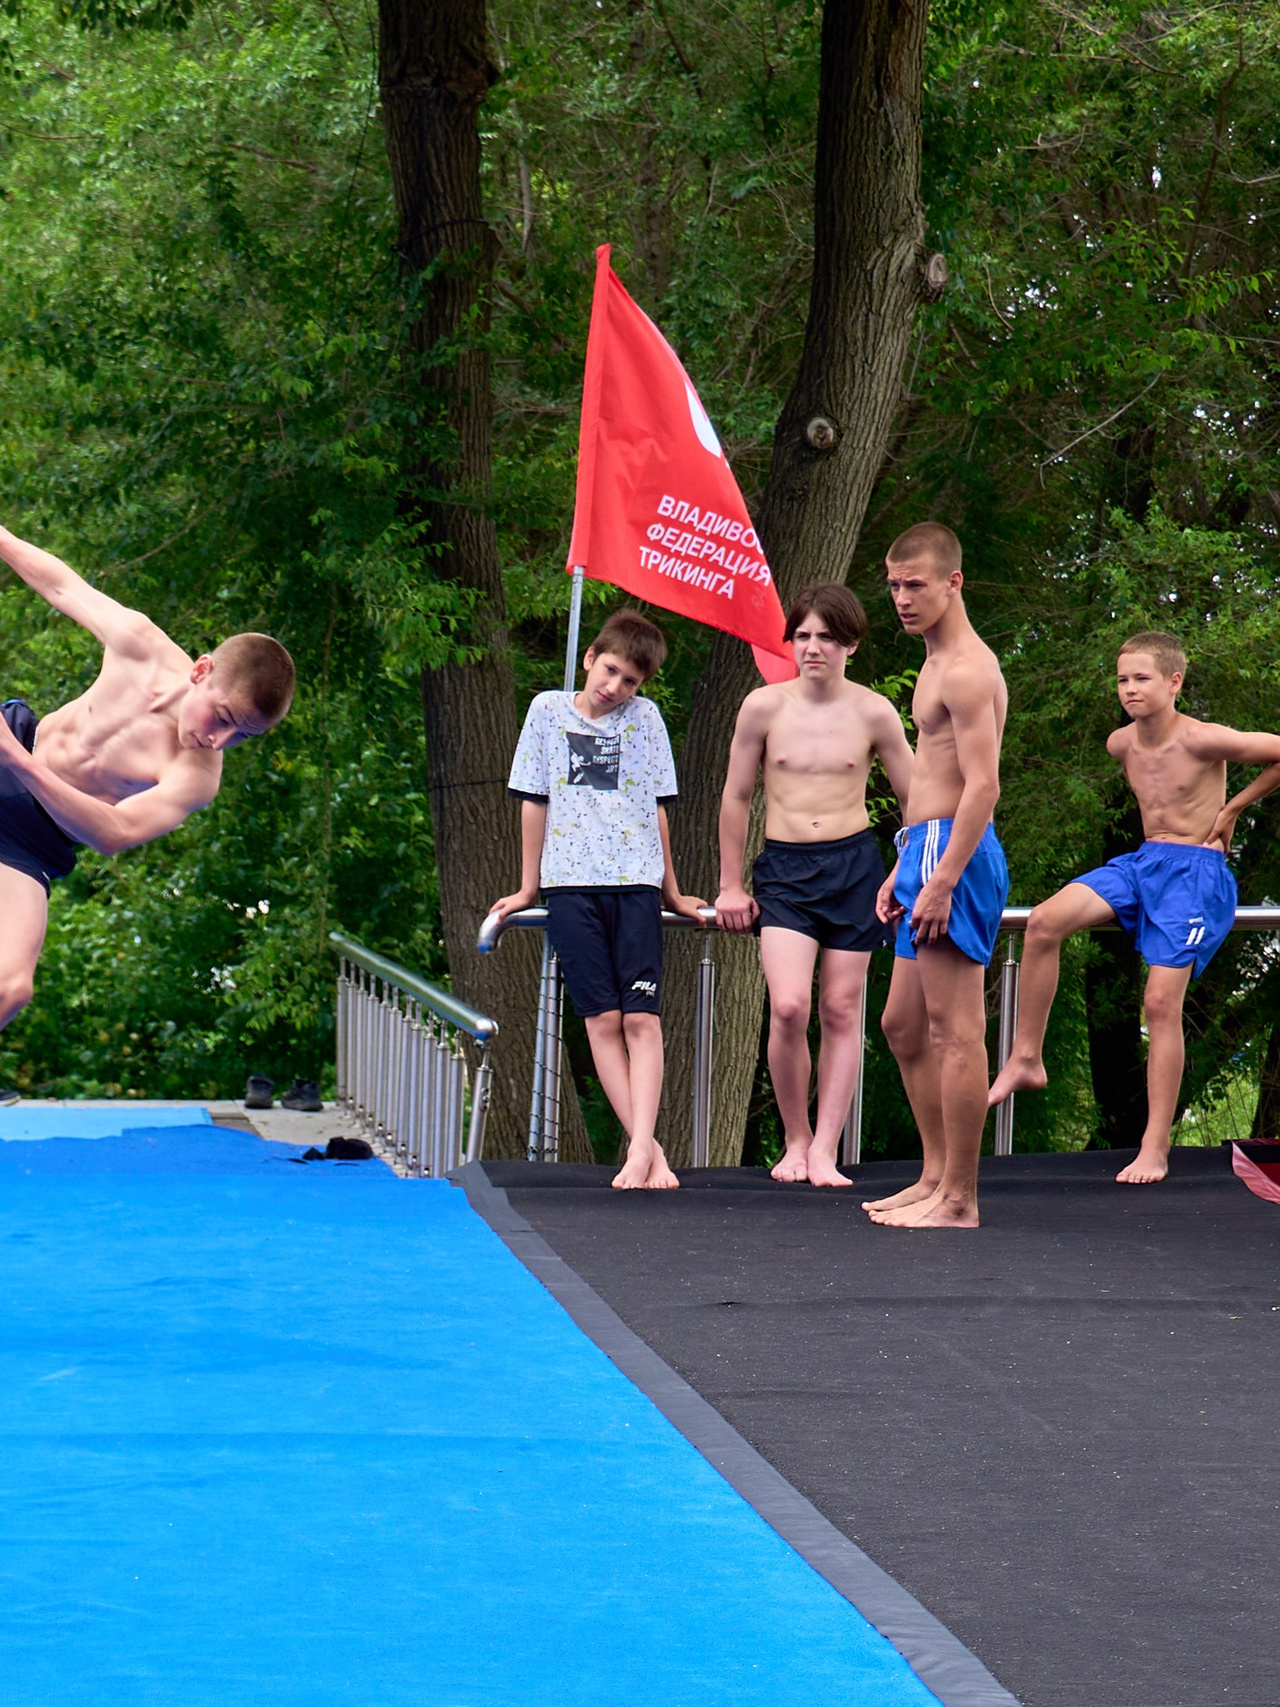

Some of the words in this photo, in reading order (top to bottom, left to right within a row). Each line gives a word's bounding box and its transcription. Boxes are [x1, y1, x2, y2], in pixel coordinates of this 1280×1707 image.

[639, 546, 734, 600] ТРИКИНГА
[646, 523, 770, 587] ФЕДЕРАЦИЯ
[631, 980, 657, 992] FILA
